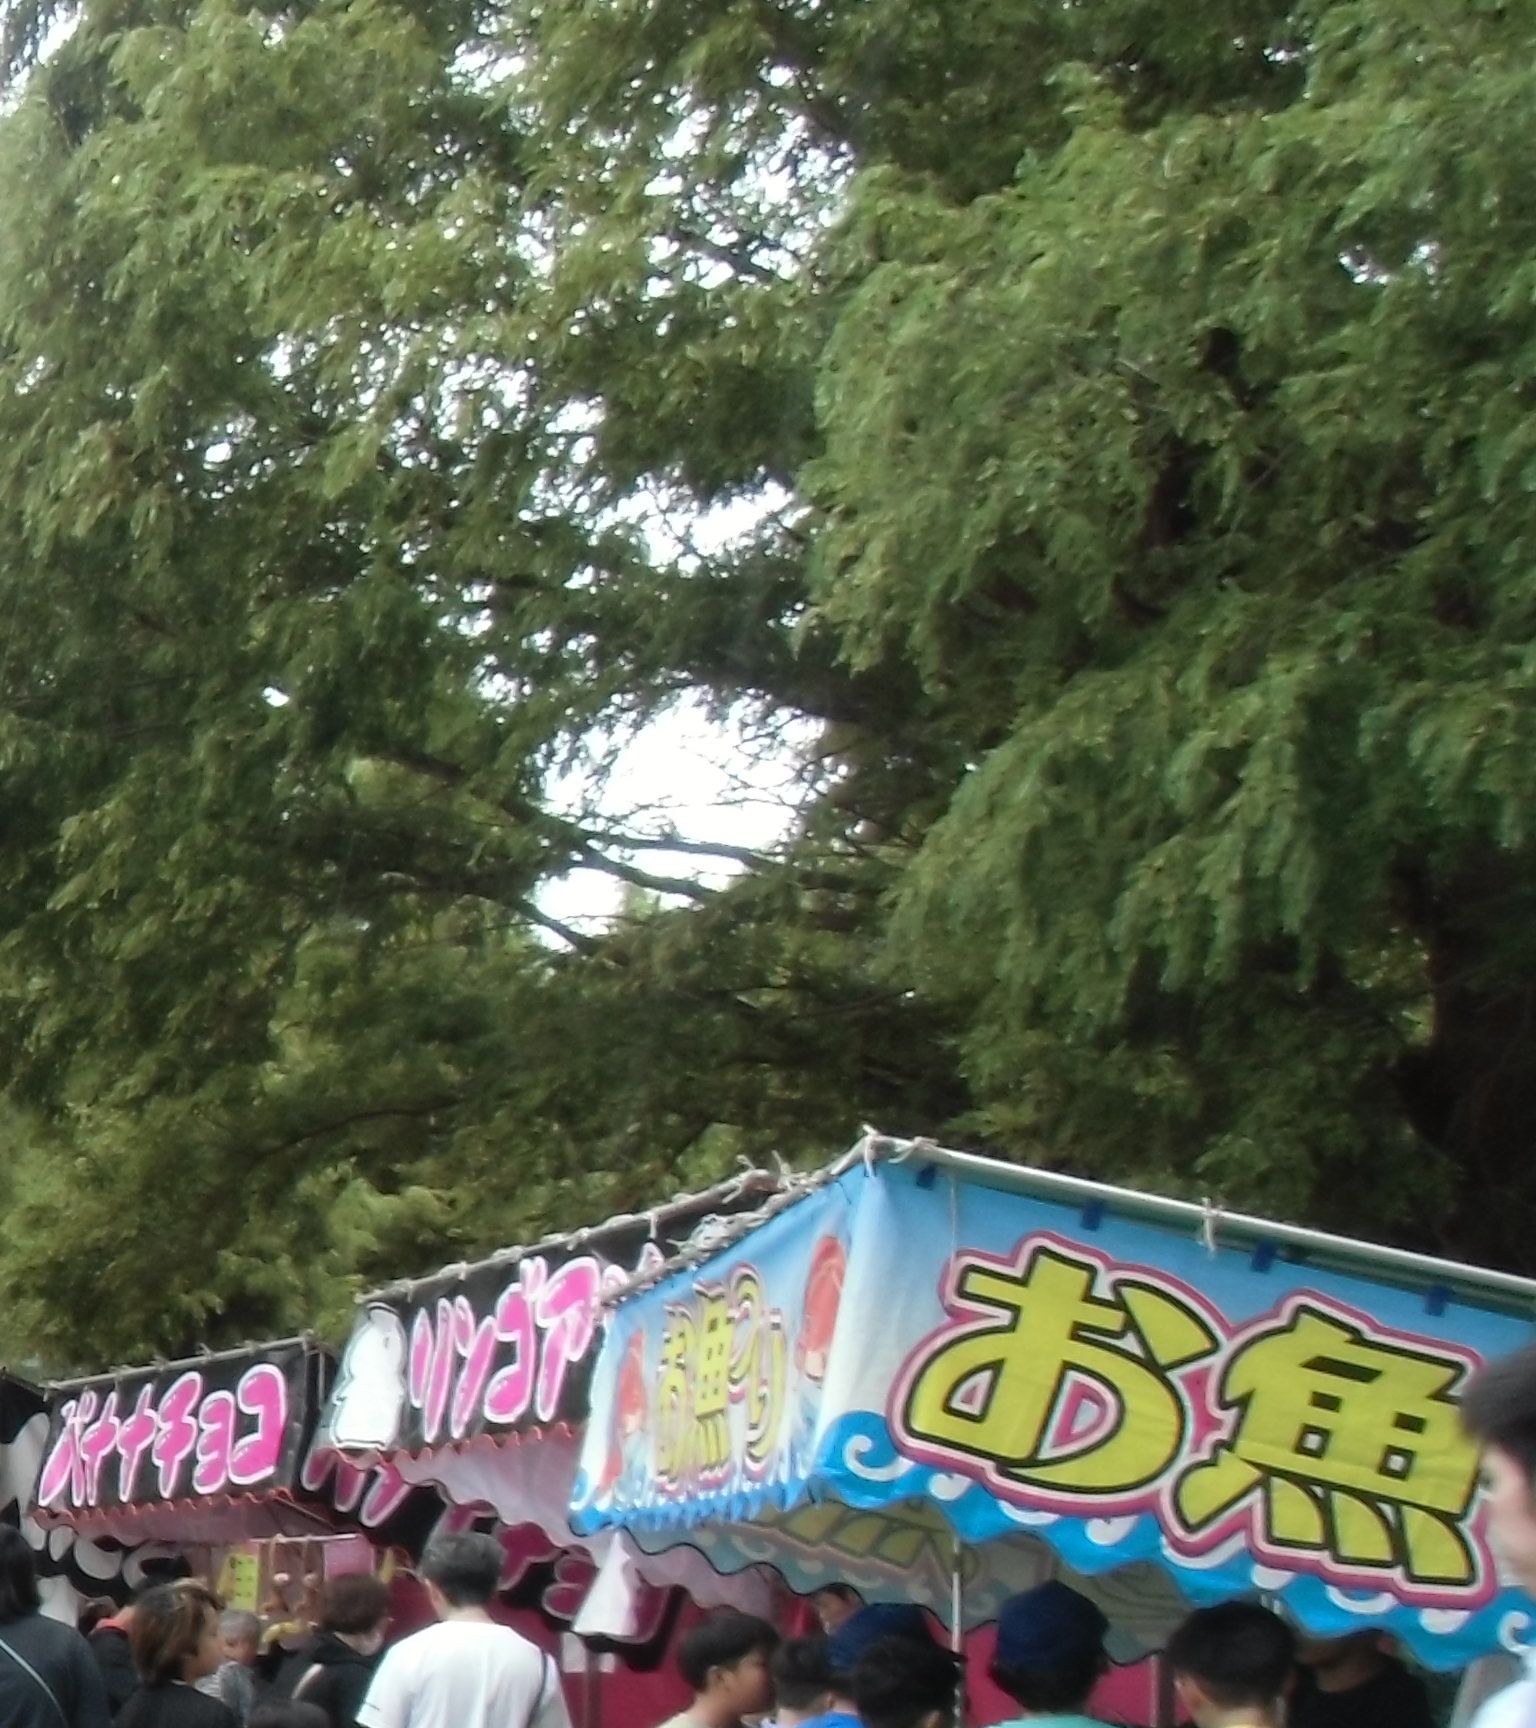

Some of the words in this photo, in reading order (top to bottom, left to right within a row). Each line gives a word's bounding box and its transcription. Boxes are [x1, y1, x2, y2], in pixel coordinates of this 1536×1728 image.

[409, 1242, 664, 1443] リンゴア
[38, 1363, 287, 1507] バナナチョコ
